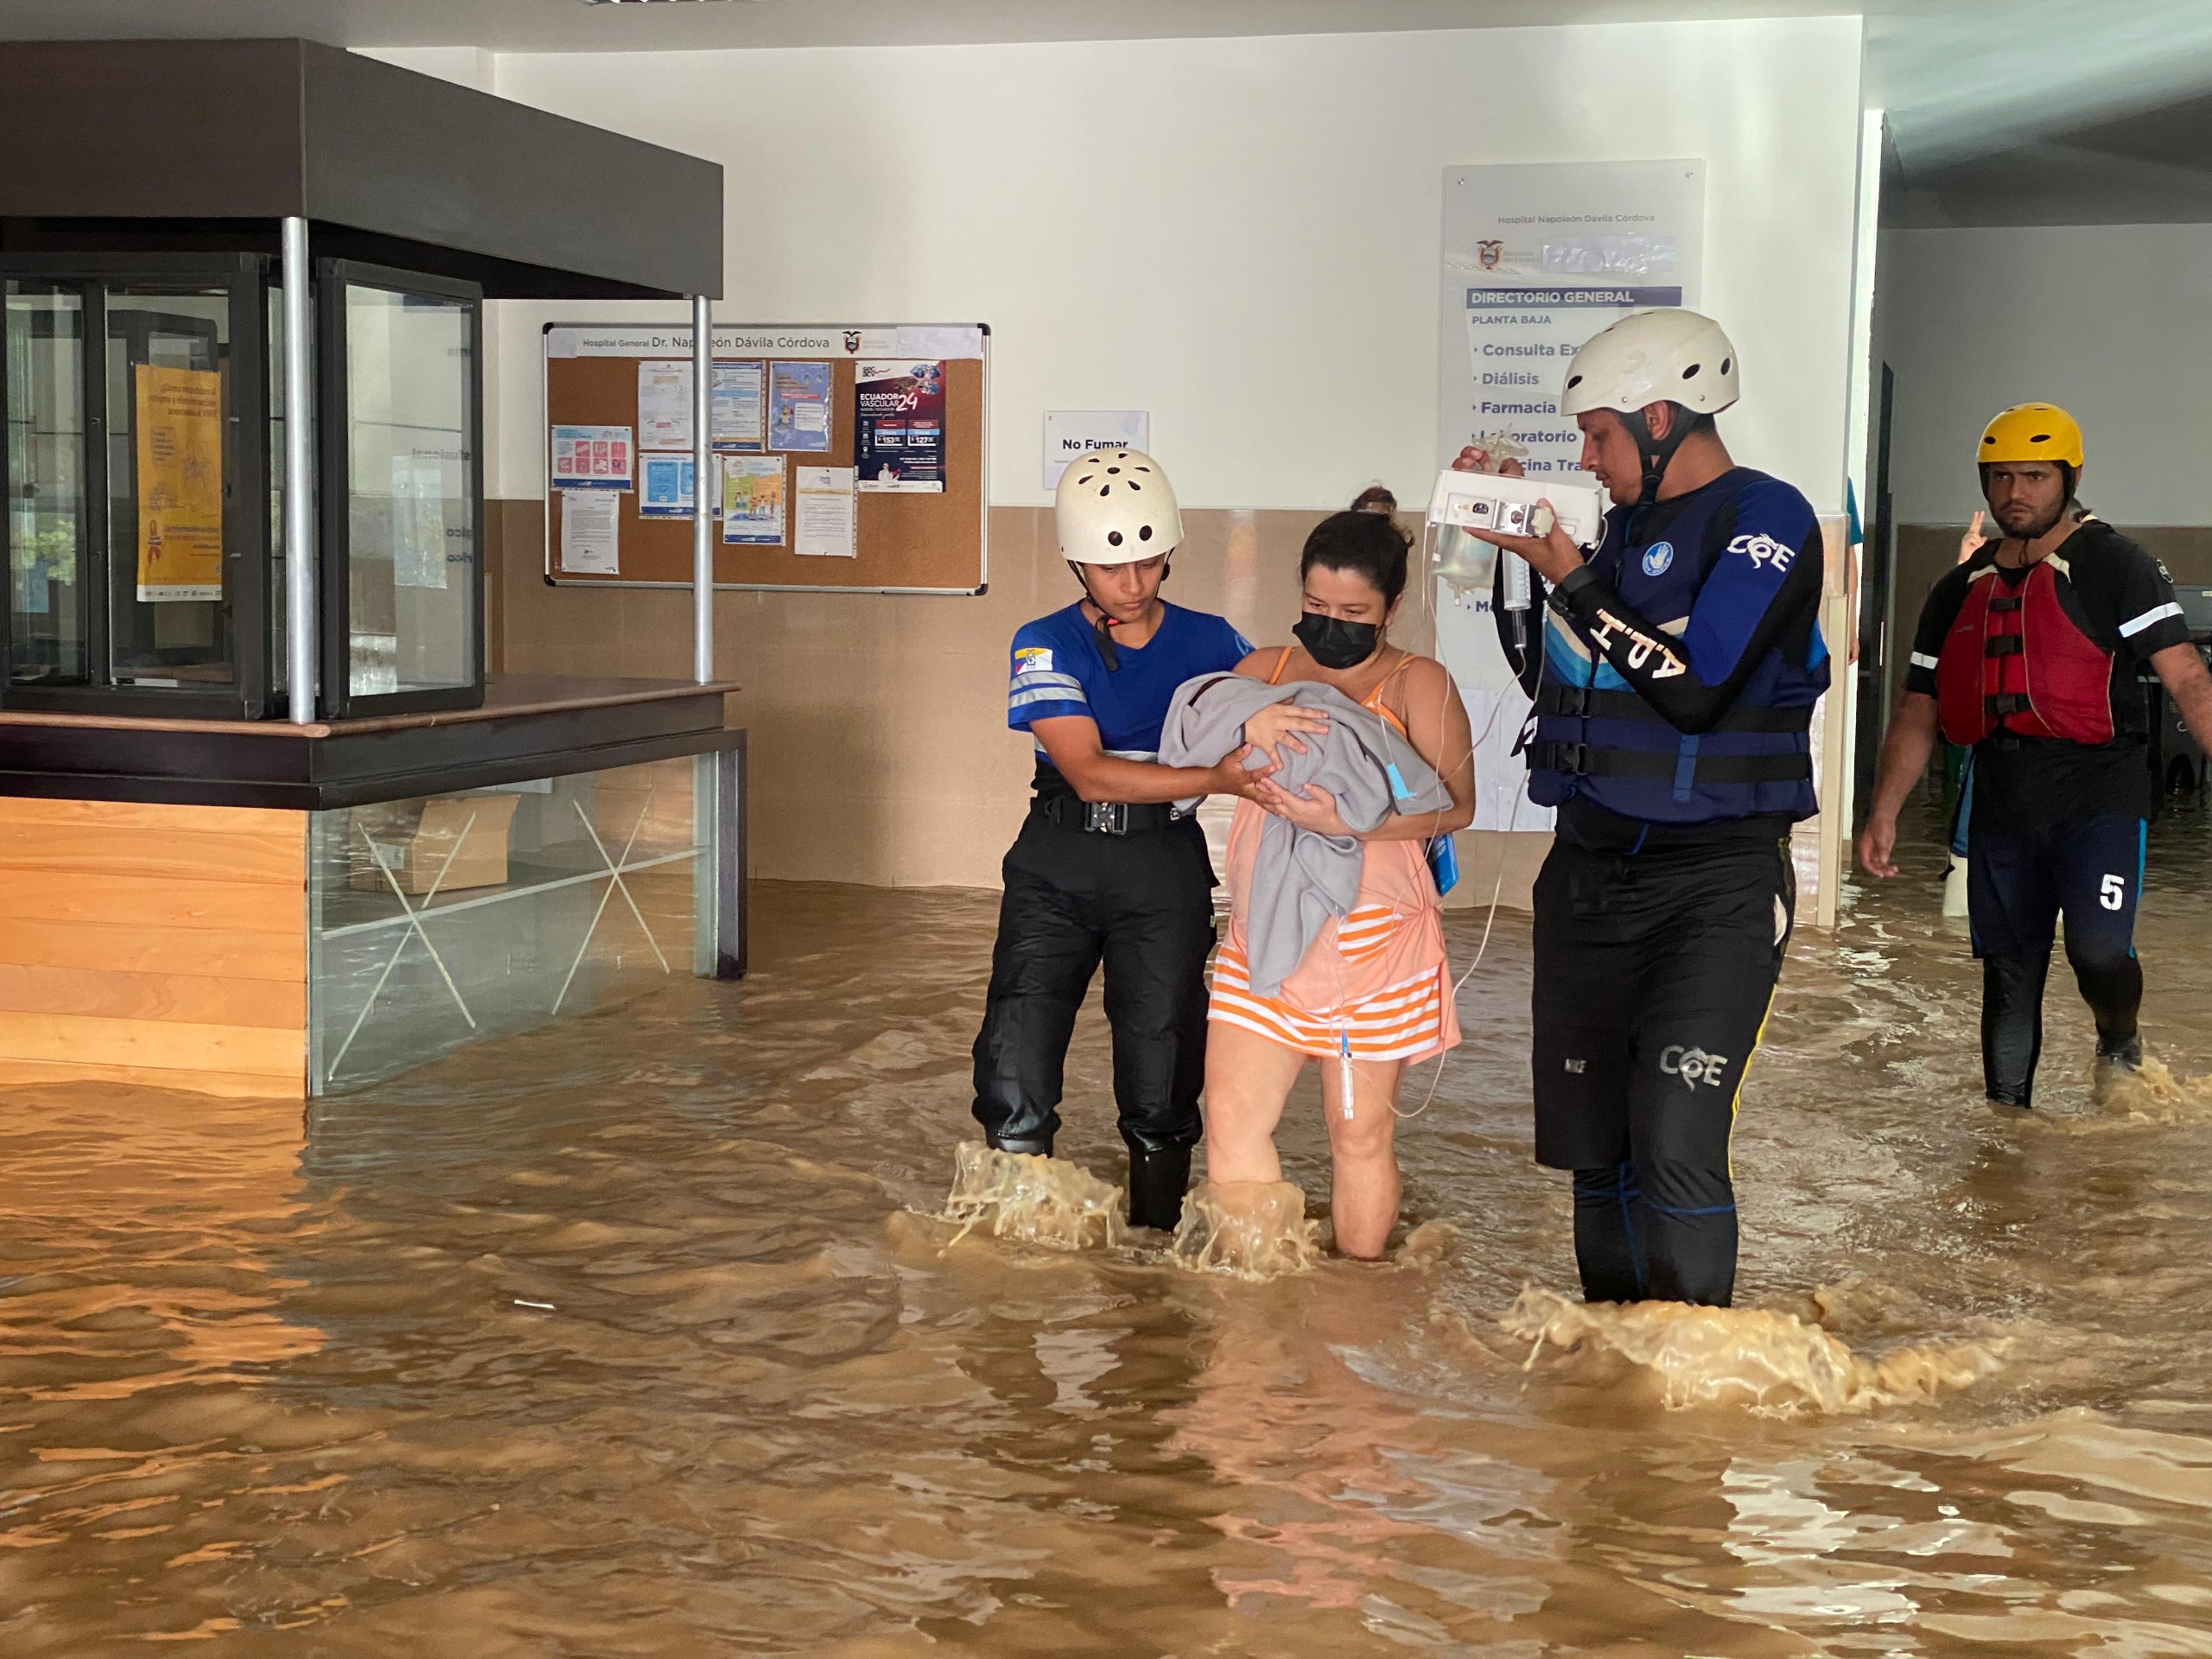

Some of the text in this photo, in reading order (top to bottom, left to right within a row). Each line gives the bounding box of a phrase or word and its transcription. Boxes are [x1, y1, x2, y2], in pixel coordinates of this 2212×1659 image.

[1497, 213, 1655, 225] Hospital Napoleón Dávila Córdova
[1471, 291, 1635, 303] DIRECTORIO GENERAL
[1471, 315, 1552, 325] PLANTA BAJA
[582, 339, 616, 348] Hospital
[652, 337, 668, 347] Dr.
[672, 336, 731, 349] Napeón
[735, 337, 773, 347] Dávila
[778, 337, 830, 347] Córdova
[1483, 343, 1586, 356] Consulta Ex
[1483, 372, 1540, 385] Diálisis
[895, 392, 918, 411] 24
[1481, 401, 1556, 414] Farmacia
[1062, 439, 1128, 449] No Fumar
[1522, 458, 1583, 471] cina Tra
[2100, 874, 2125, 911] 5
